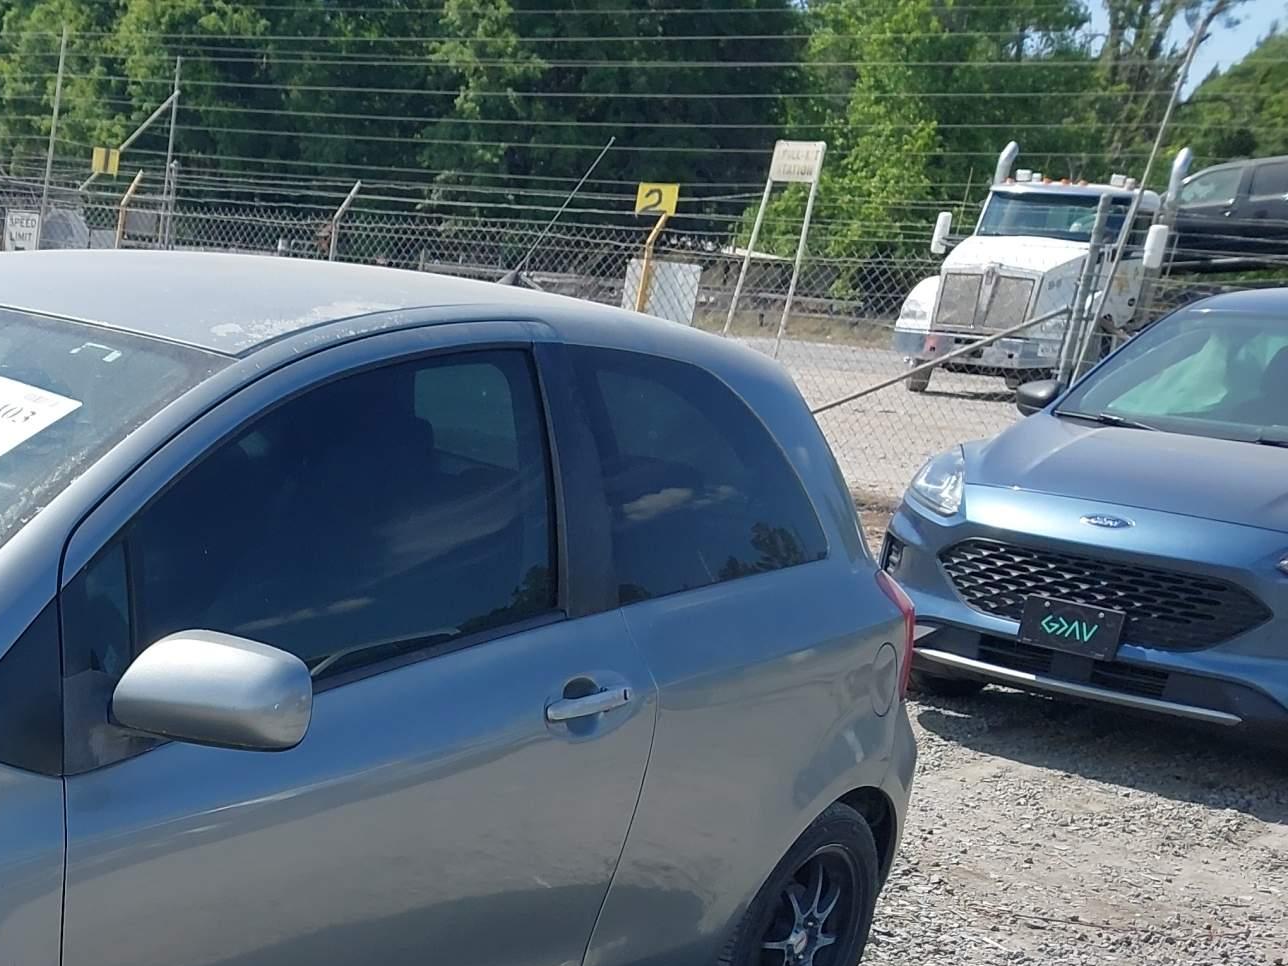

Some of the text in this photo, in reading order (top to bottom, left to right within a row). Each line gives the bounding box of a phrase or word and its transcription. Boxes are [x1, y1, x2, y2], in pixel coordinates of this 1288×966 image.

[639, 188, 667, 214] 2
[9, 215, 37, 228] SPEED
[9, 231, 32, 241] LIMIT
